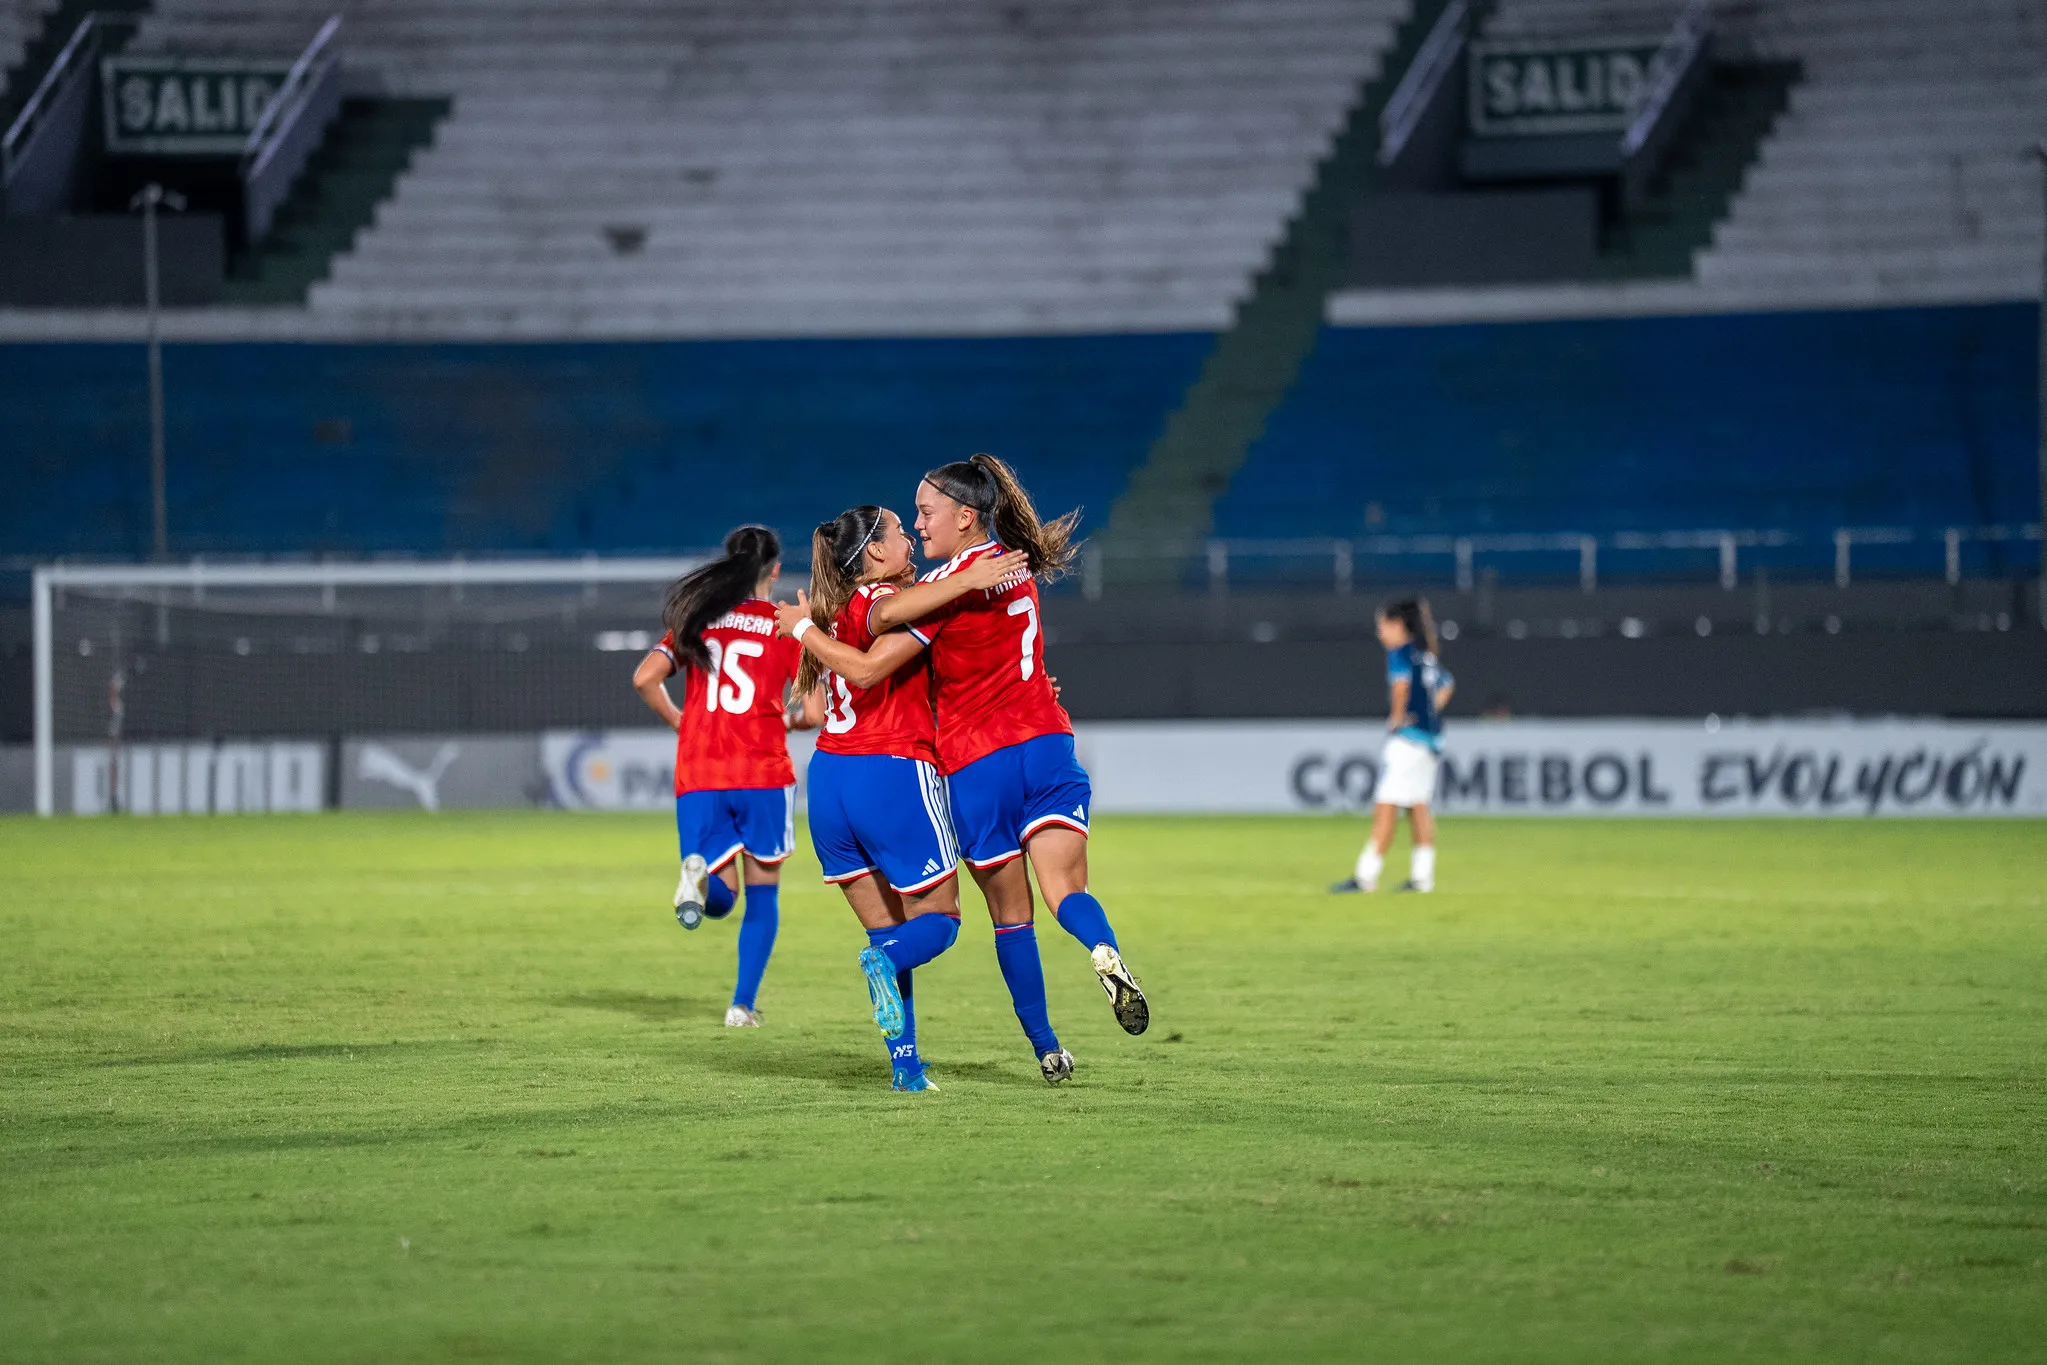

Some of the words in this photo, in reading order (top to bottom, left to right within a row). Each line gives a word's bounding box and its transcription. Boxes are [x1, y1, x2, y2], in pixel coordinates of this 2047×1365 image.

[121, 75, 273, 131] SALID
[1487, 55, 1650, 113] SALID
[1007, 596, 1037, 681] 7
[705, 638, 764, 715] 15
[1293, 753, 1671, 804] COMEBOL
